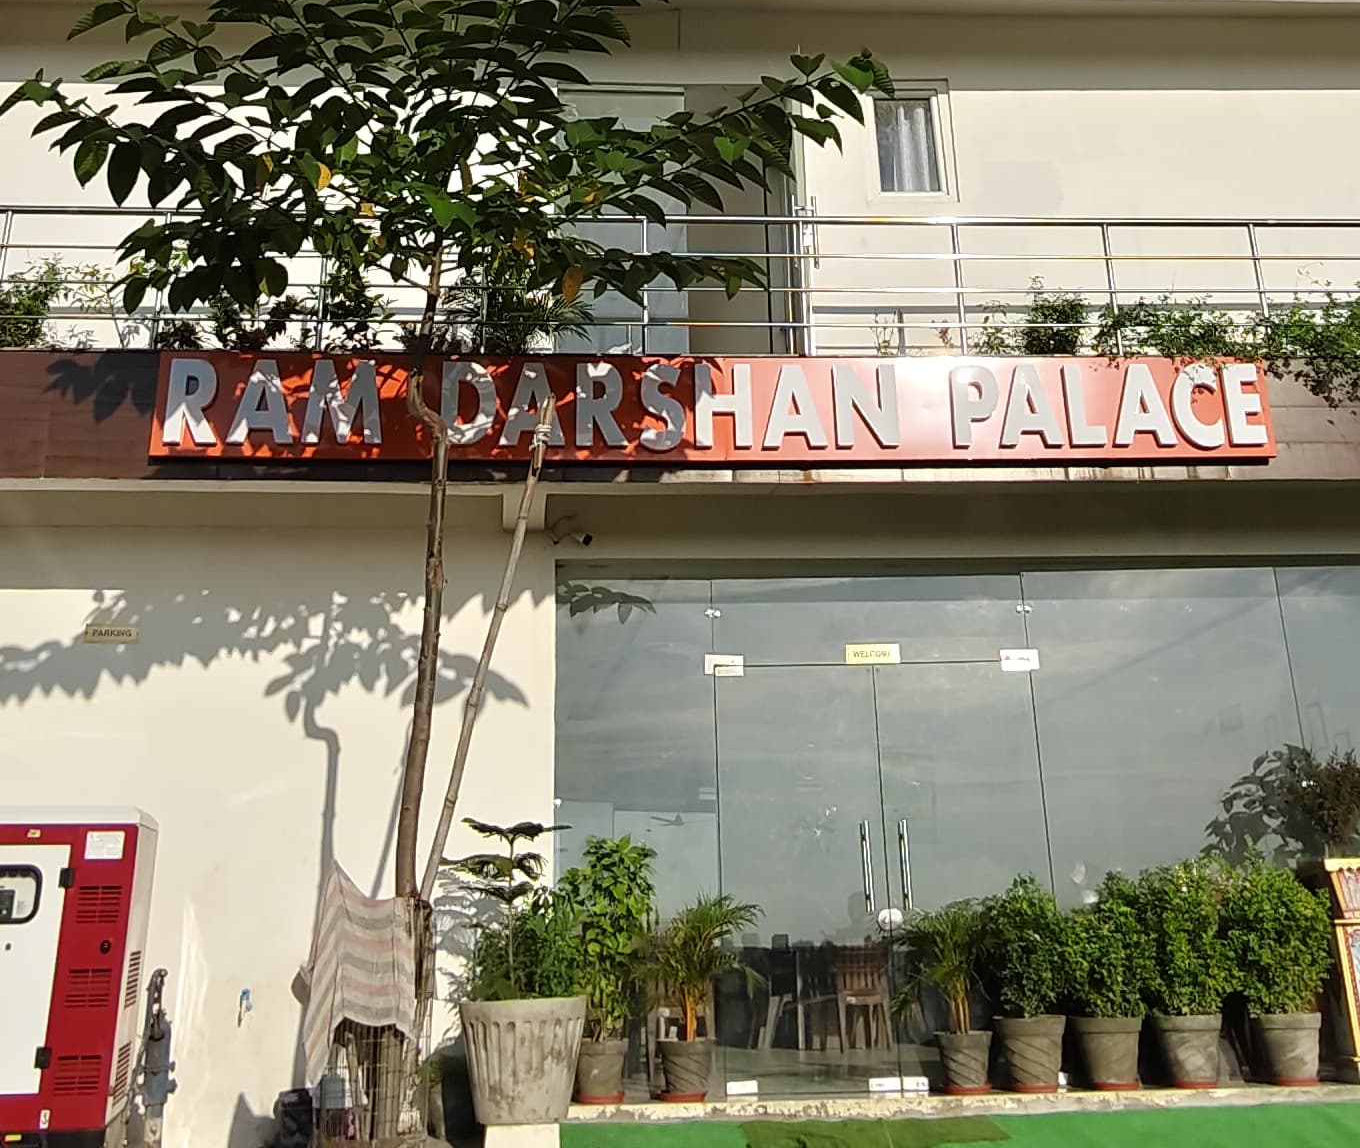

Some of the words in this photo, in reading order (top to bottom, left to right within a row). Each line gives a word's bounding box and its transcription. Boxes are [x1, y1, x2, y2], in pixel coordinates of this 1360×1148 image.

[161, 357, 383, 447] RAM
[440, 360, 902, 452] DARSHAN
[949, 362, 1270, 452] PALACE
[91, 629, 132, 637] PARKING
